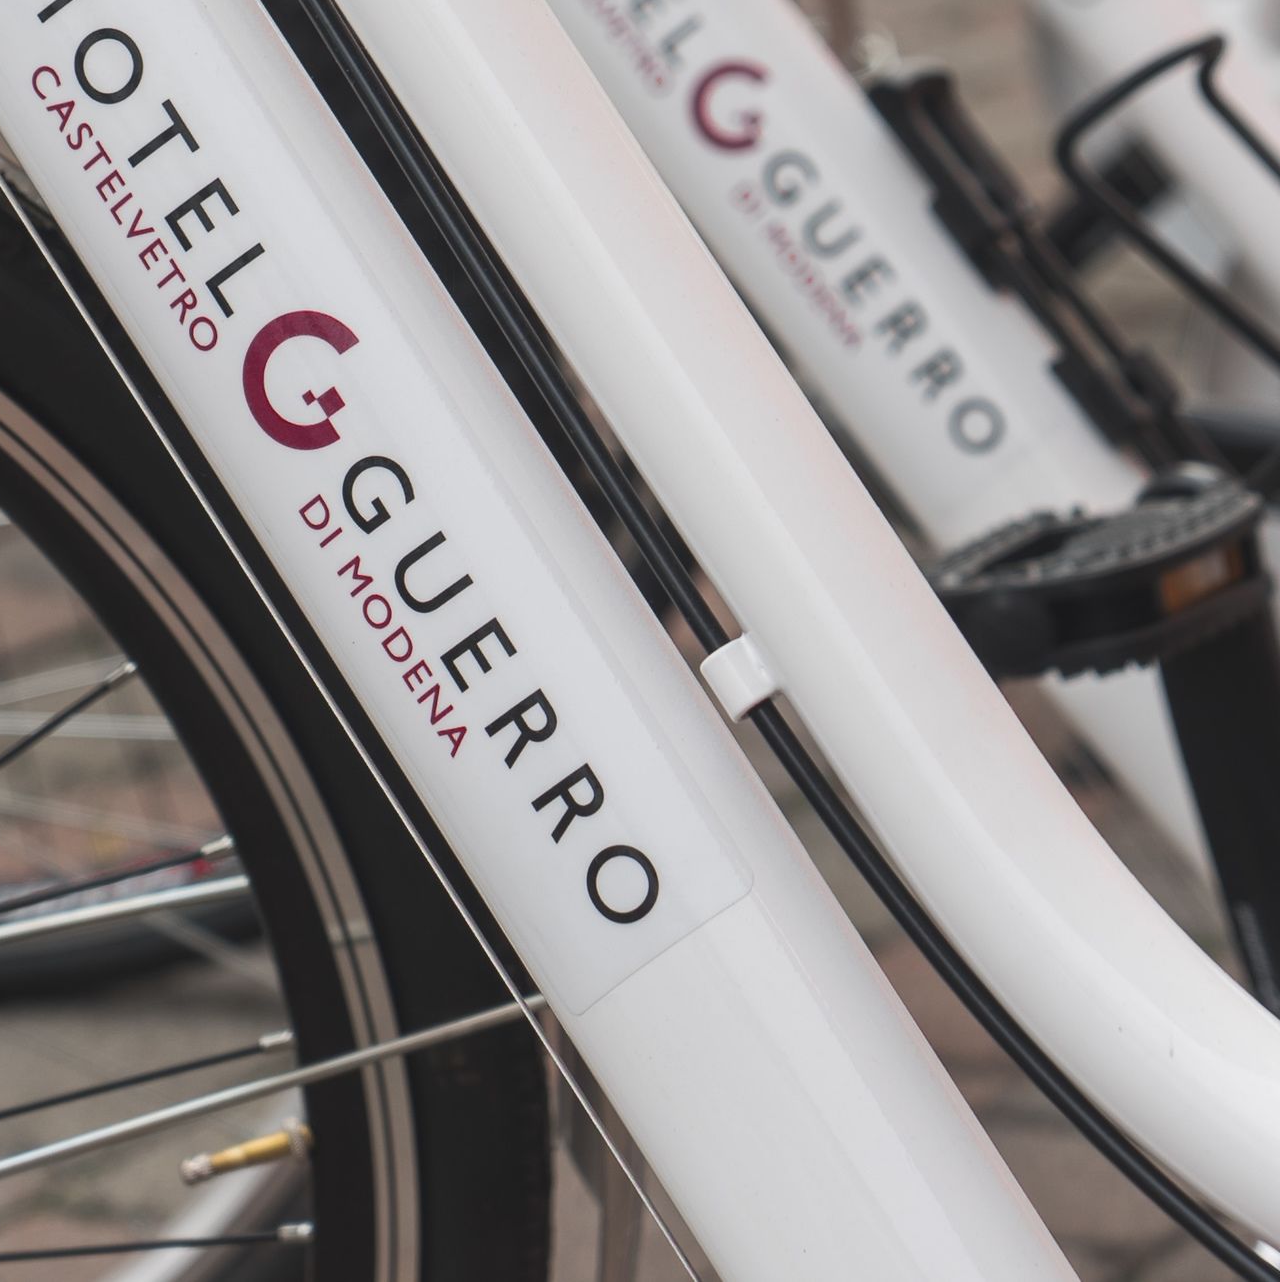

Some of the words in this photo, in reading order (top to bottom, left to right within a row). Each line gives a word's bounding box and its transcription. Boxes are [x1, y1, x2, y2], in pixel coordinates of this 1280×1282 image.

[30, 64, 219, 354] CASTELVETRO
[297, 494, 343, 551] DI
[338, 554, 467, 759] MODENA
[761, 149, 1006, 456] GUERRO
[241, 309, 361, 451] G
[341, 455, 660, 925] GUERRO
